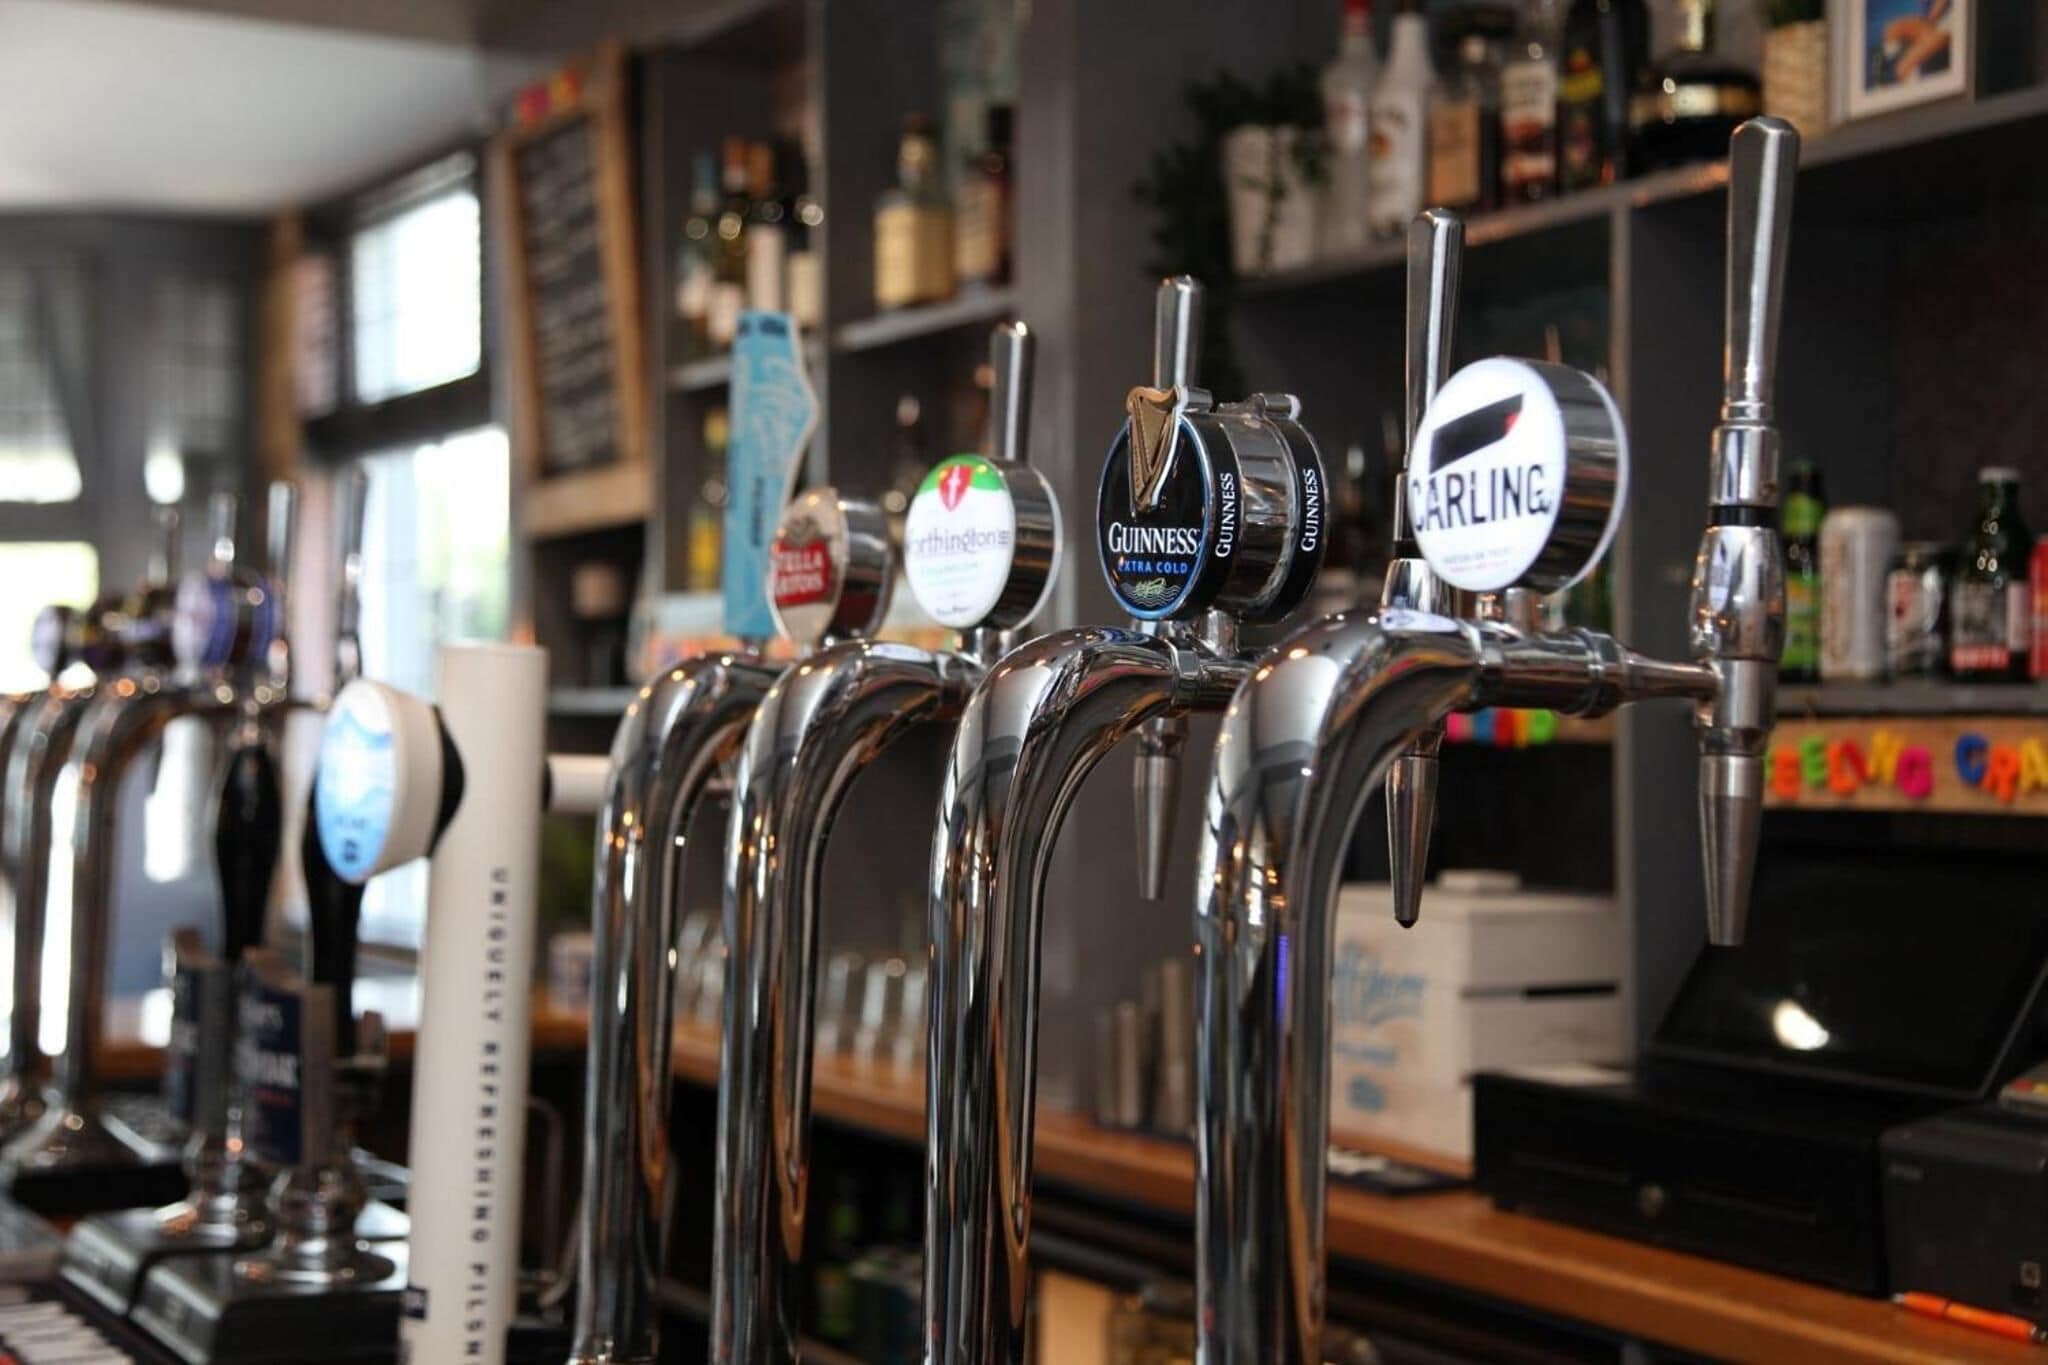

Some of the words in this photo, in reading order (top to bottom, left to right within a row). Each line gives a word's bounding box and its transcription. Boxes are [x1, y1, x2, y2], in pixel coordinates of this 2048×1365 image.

[1108, 522, 1198, 555] GUINNESS
[1215, 471, 1236, 558] GUINNESS
[1301, 467, 1321, 552] GUINNESS
[1411, 464, 1547, 532] CARLING
[1118, 559, 1153, 574] EXTRA
[1156, 559, 1188, 574] COLD
[483, 867, 509, 1021] UNIQUELY
[471, 1041, 500, 1243] REFRESHING
[465, 1262, 489, 1365] PILSN
